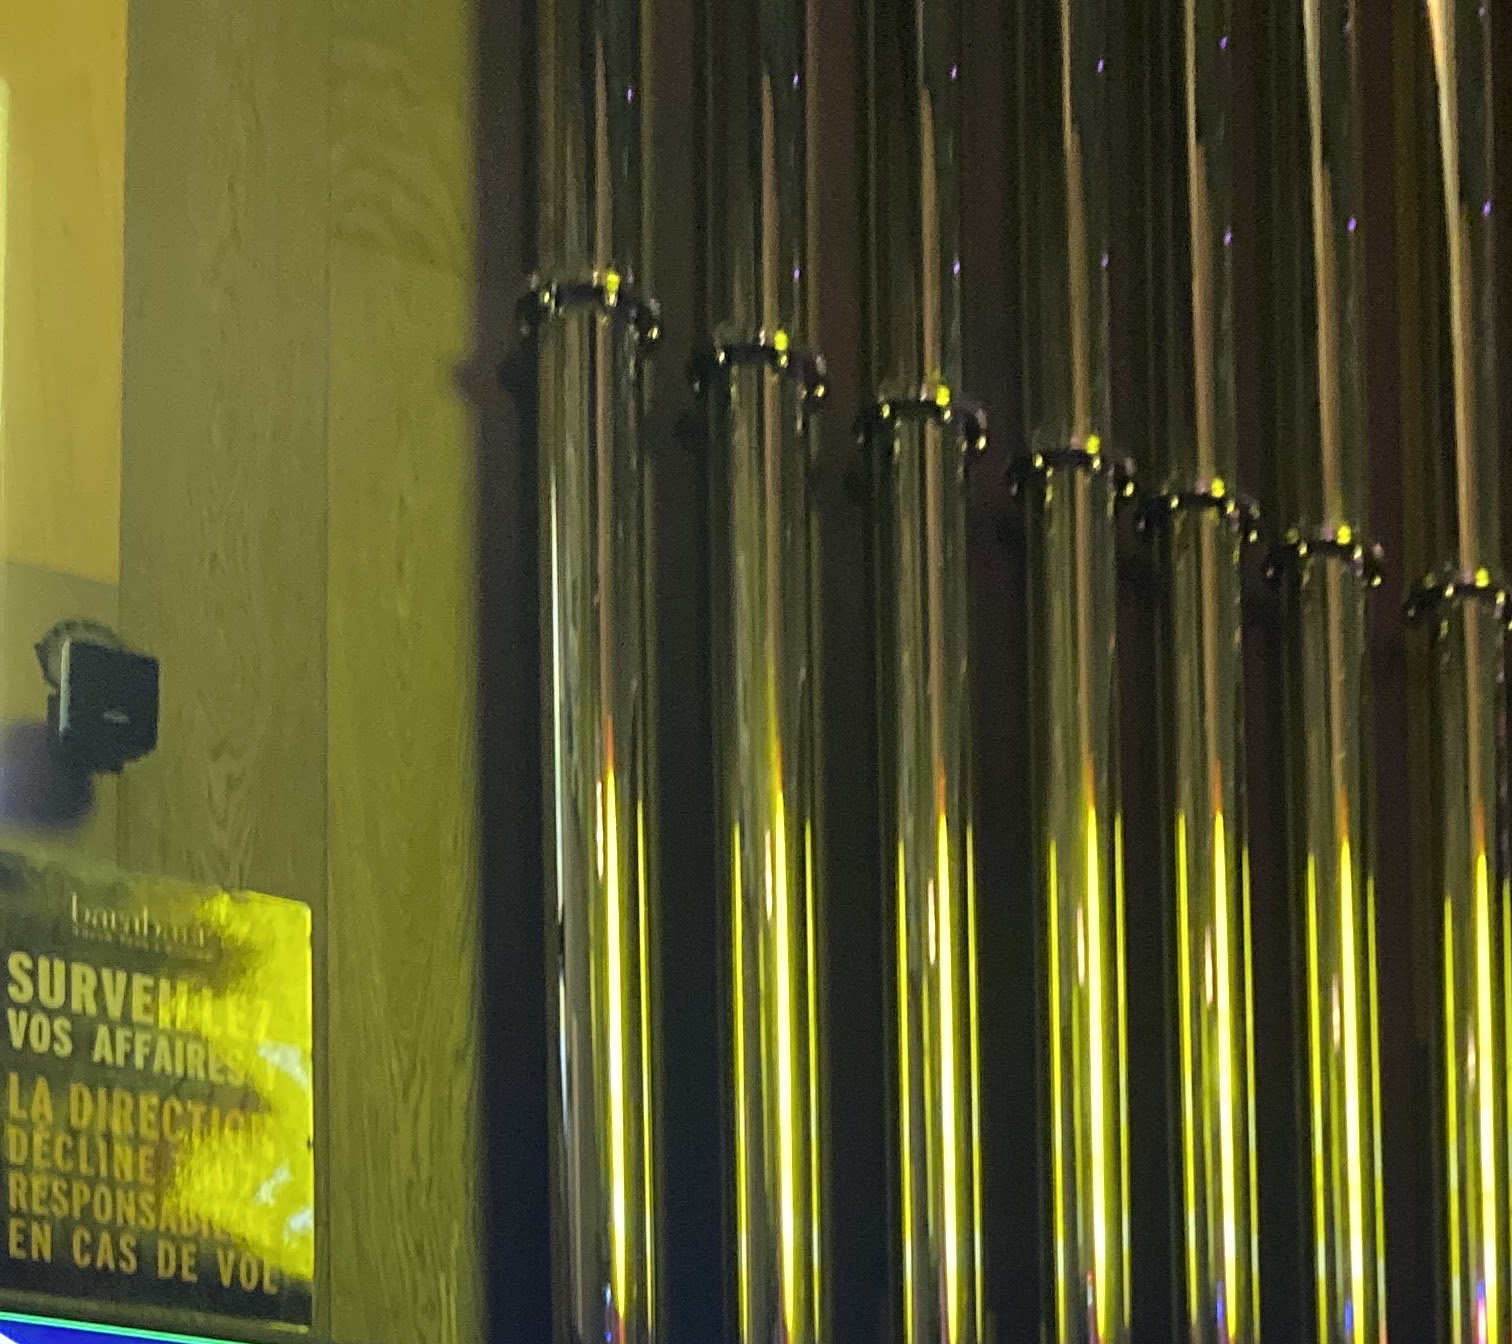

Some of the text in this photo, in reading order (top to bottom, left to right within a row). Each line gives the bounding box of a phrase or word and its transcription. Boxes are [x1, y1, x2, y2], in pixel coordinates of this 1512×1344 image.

[7, 1007, 73, 1058] VOS
[92, 1022, 247, 1088] AFFAIRES
[8, 1072, 53, 1126] LA
[8, 1217, 278, 1295] EN CAS DE VOL
